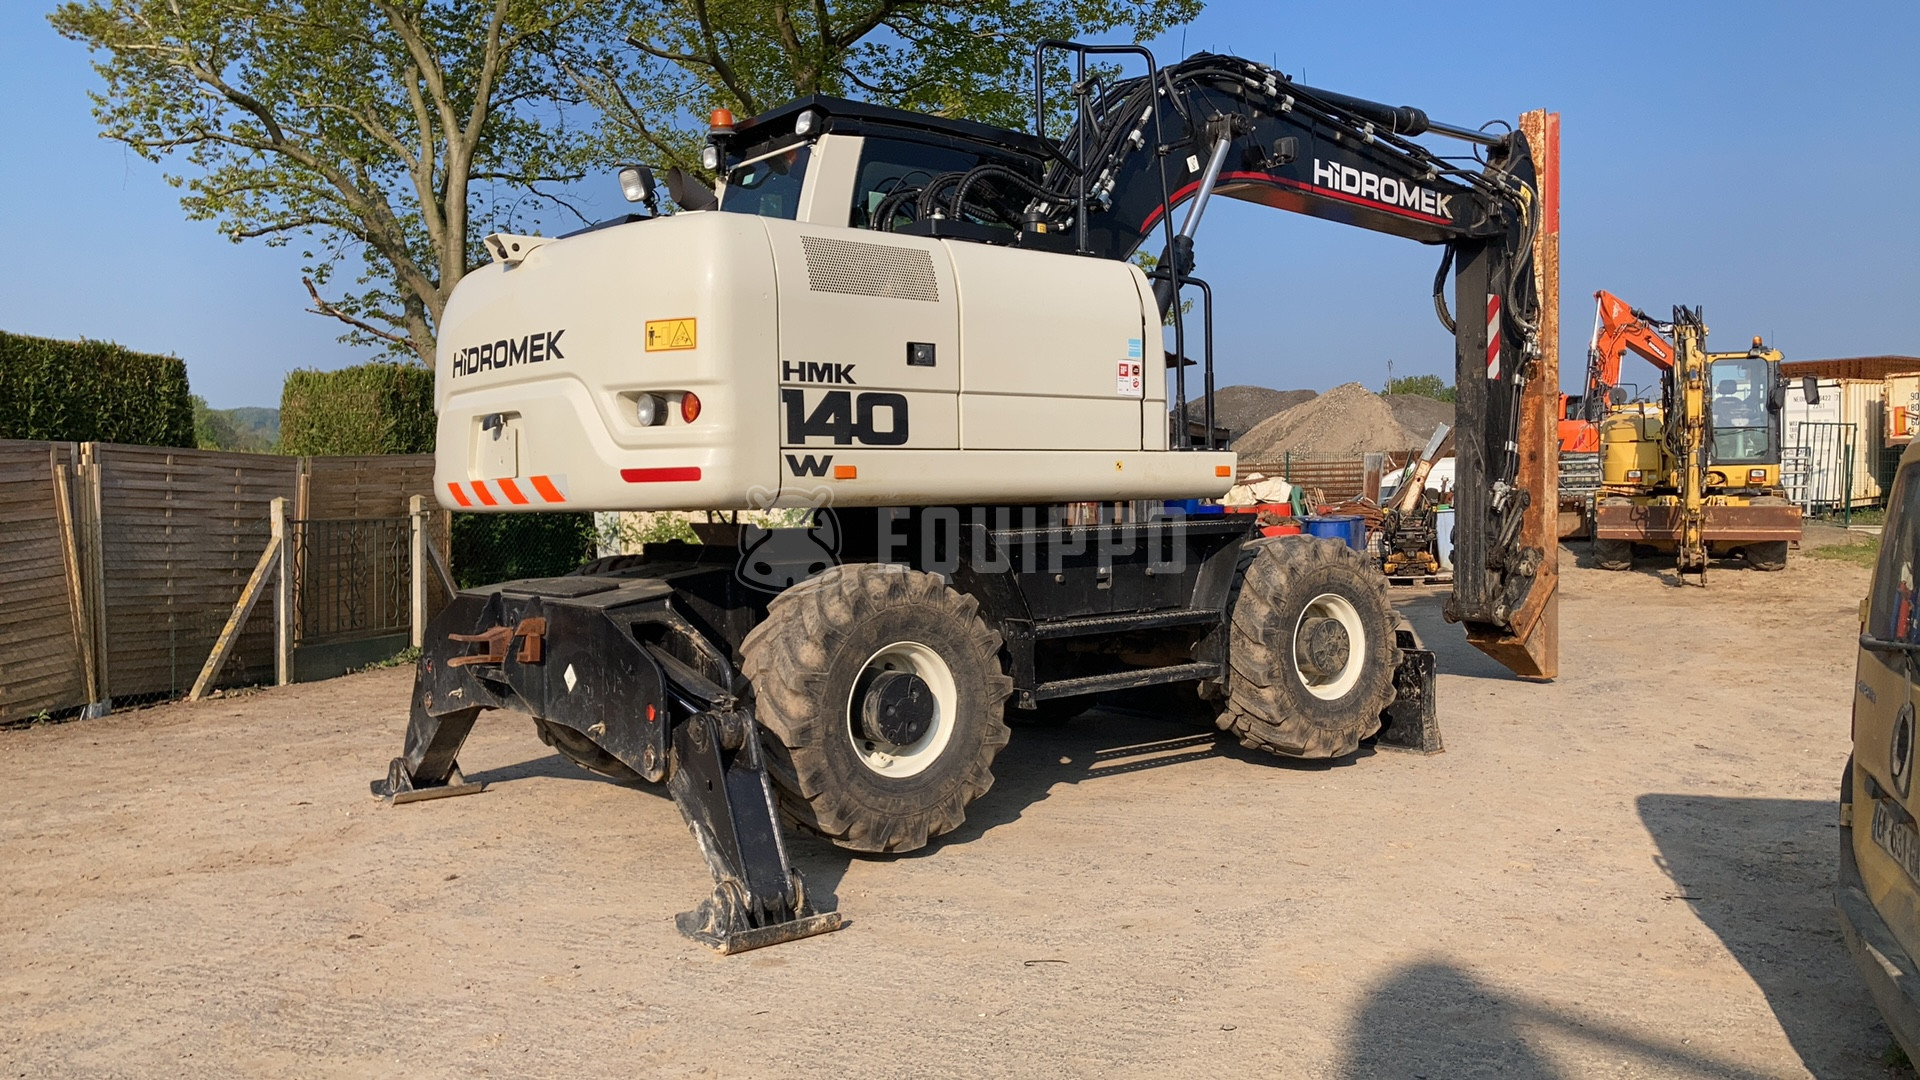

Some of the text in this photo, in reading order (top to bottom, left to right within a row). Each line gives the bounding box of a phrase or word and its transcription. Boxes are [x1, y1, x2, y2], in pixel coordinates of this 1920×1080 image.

[783, 360, 856, 384] HMK
[782, 388, 908, 445] 140
[784, 455, 833, 477] W
